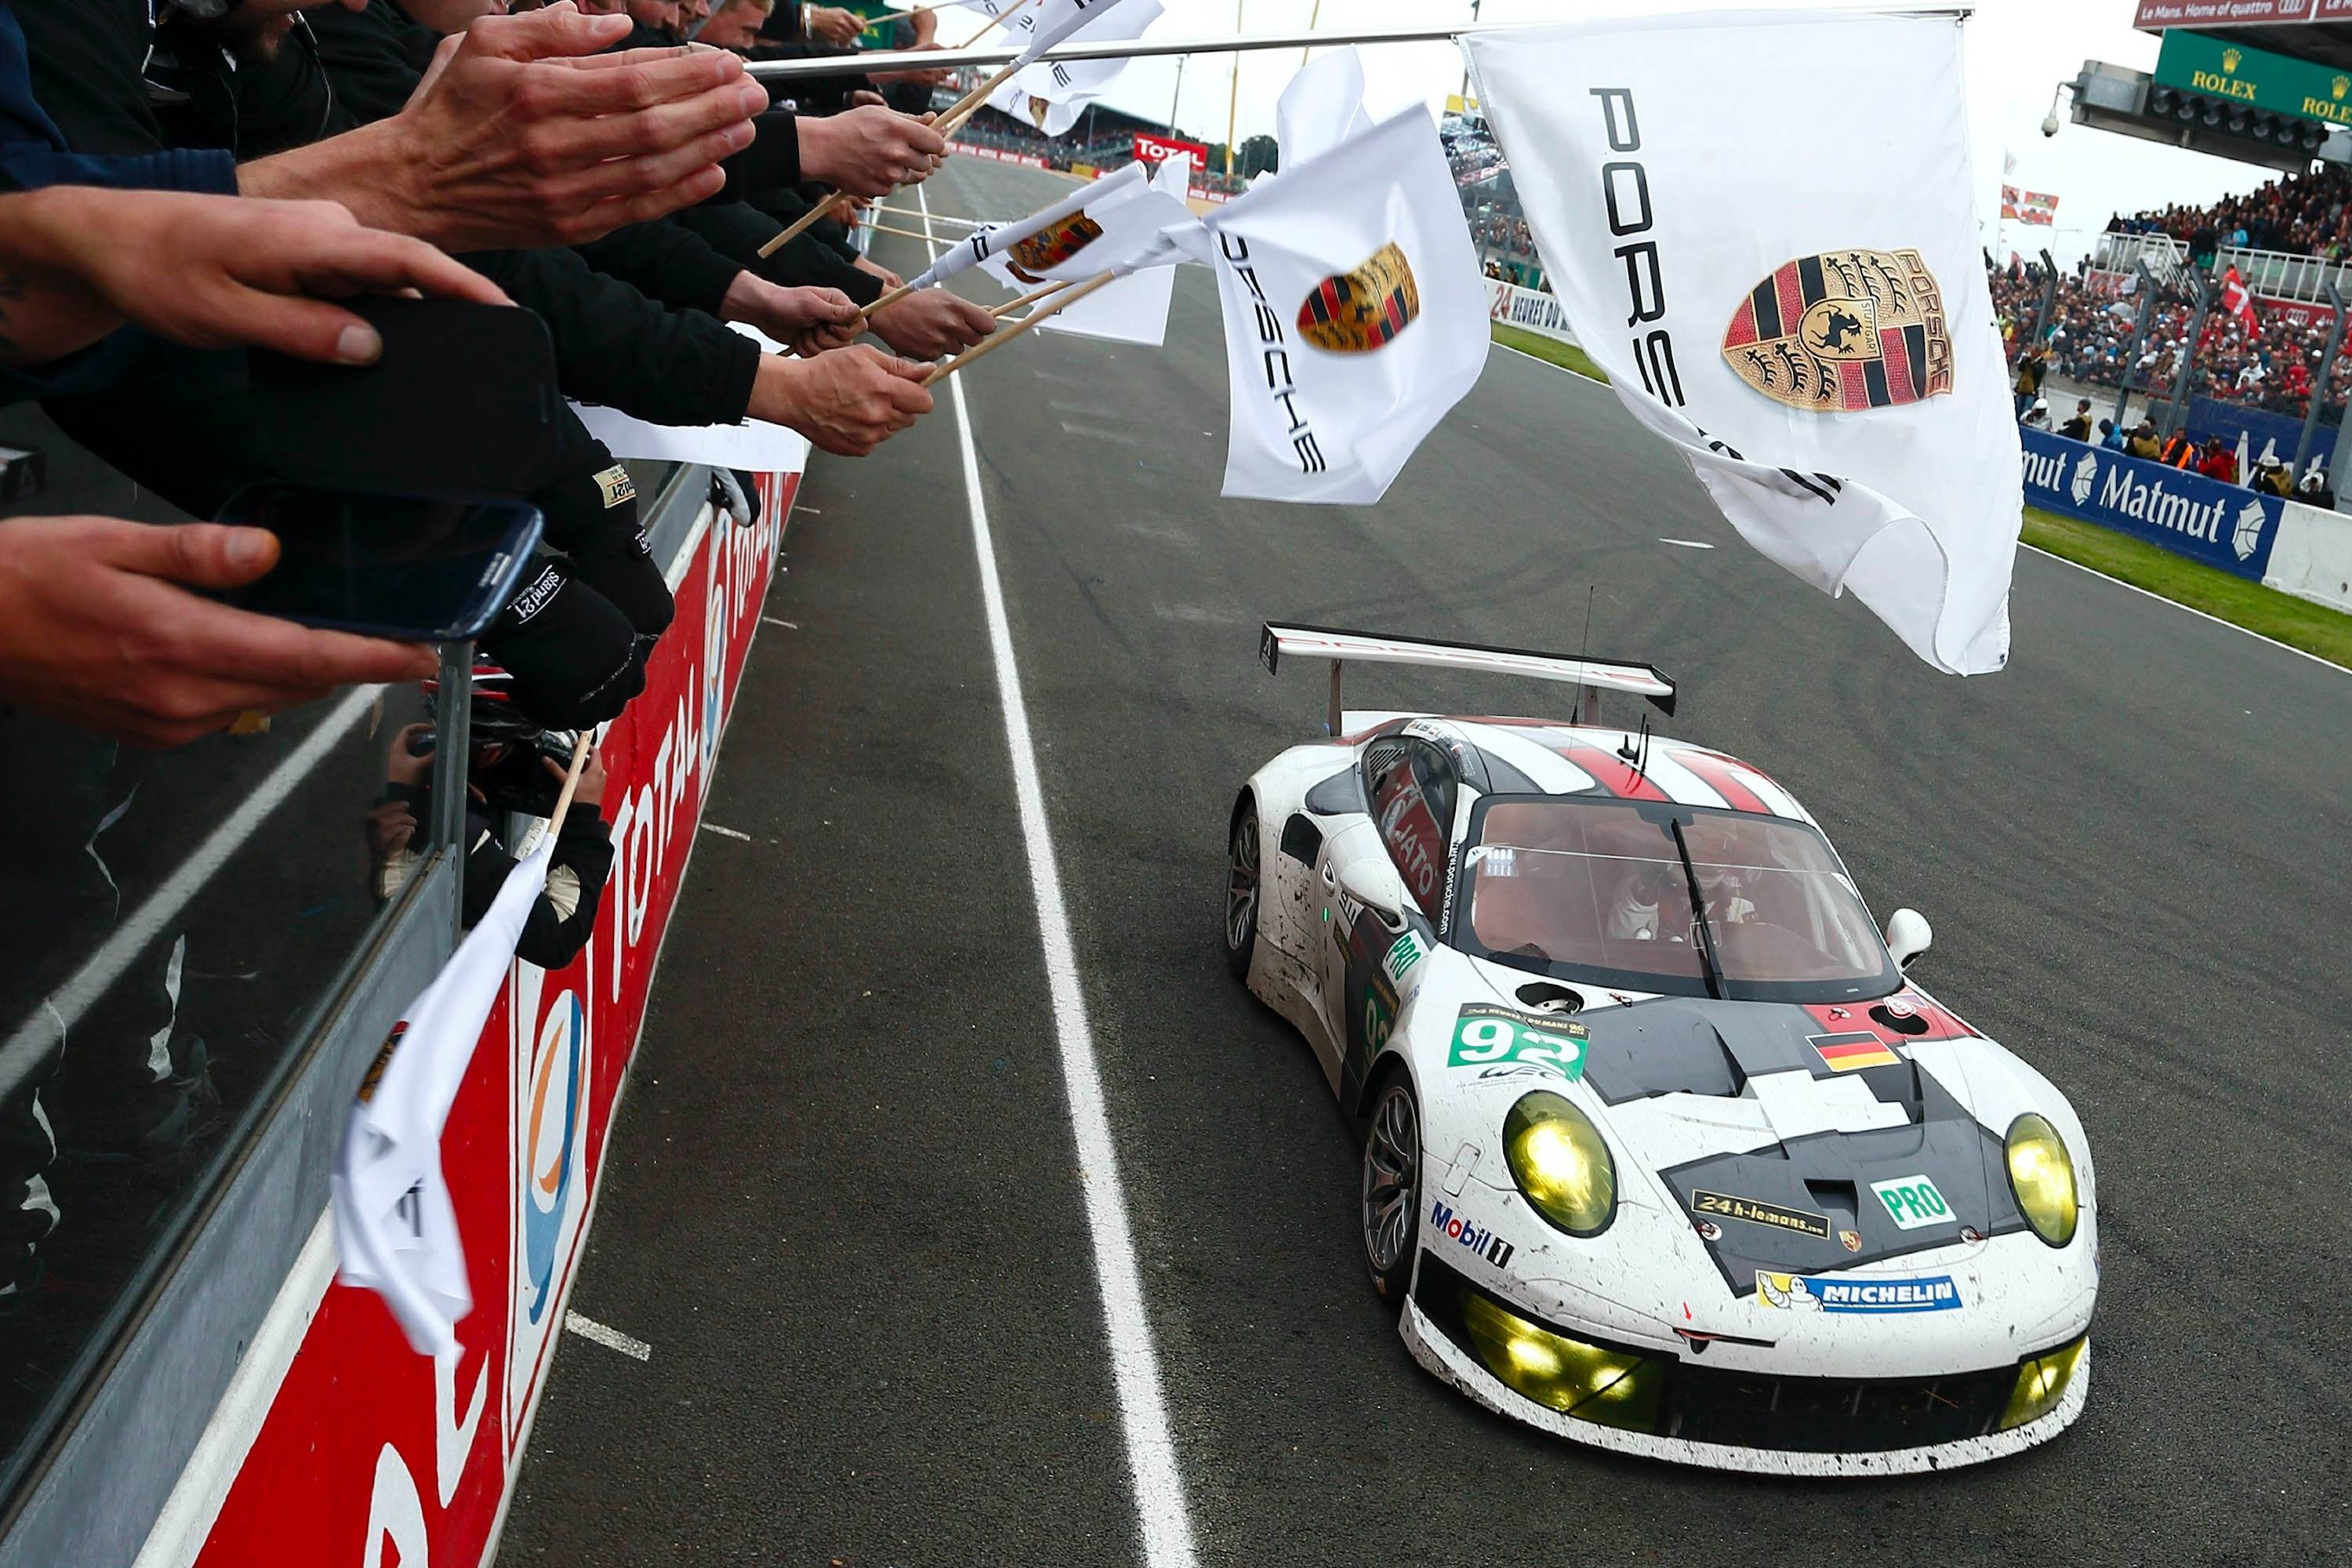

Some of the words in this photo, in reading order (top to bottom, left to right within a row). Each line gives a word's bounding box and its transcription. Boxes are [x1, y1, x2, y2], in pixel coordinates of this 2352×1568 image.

[2141, 7, 2154, 20] Le
[2184, 3, 2216, 18] Home
[2217, 1, 2231, 16] of
[2230, 1, 2273, 19] quattro
[2192, 71, 2257, 100] ROLEX
[2301, 97, 2352, 124] ROLE
[1491, 284, 1513, 319] 24
[1512, 296, 1545, 327] HEURES
[1860, 302, 1878, 354] STUTTGART
[1900, 253, 1949, 392] PORSCHE
[2099, 464, 2226, 544] Matmut
[605, 662, 699, 1004] TOTAL
[1385, 935, 1421, 981] PRO
[1459, 1018, 1581, 1077] 92
[1878, 1183, 1947, 1223] PRO
[1431, 1200, 1492, 1256] Mobil
[1823, 1282, 1954, 1303] MICHELIN
